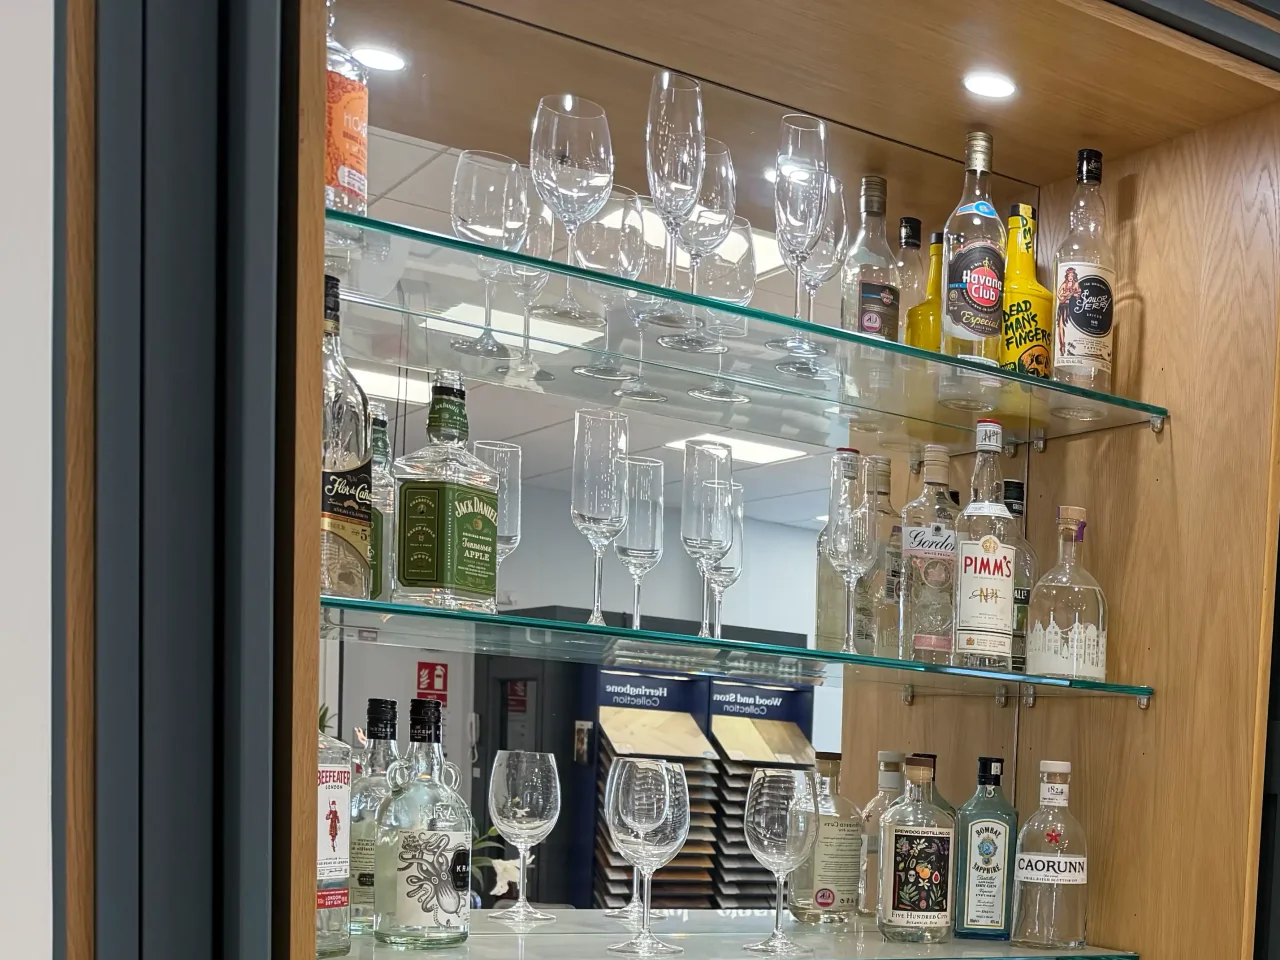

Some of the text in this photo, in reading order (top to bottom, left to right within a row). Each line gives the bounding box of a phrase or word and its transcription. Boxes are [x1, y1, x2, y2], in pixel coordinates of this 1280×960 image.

[962, 270, 1002, 290] Havana
[971, 284, 996, 301] Club
[960, 310, 999, 329] Especial
[1002, 302, 1032, 324] DEAD
[1004, 312, 1039, 337] MAN'S
[1005, 327, 1051, 350] FINGERS
[324, 475, 350, 496] Flor
[455, 500, 474, 518] JACK
[464, 549, 490, 561] APPLE
[963, 555, 1012, 578] PIMM'S
[975, 826, 1002, 838] BOMBAY
[972, 862, 1002, 875] SAPPHIRE
[1018, 857, 1085, 875] CAORUNN
[906, 911, 936, 920] HUNDRED
